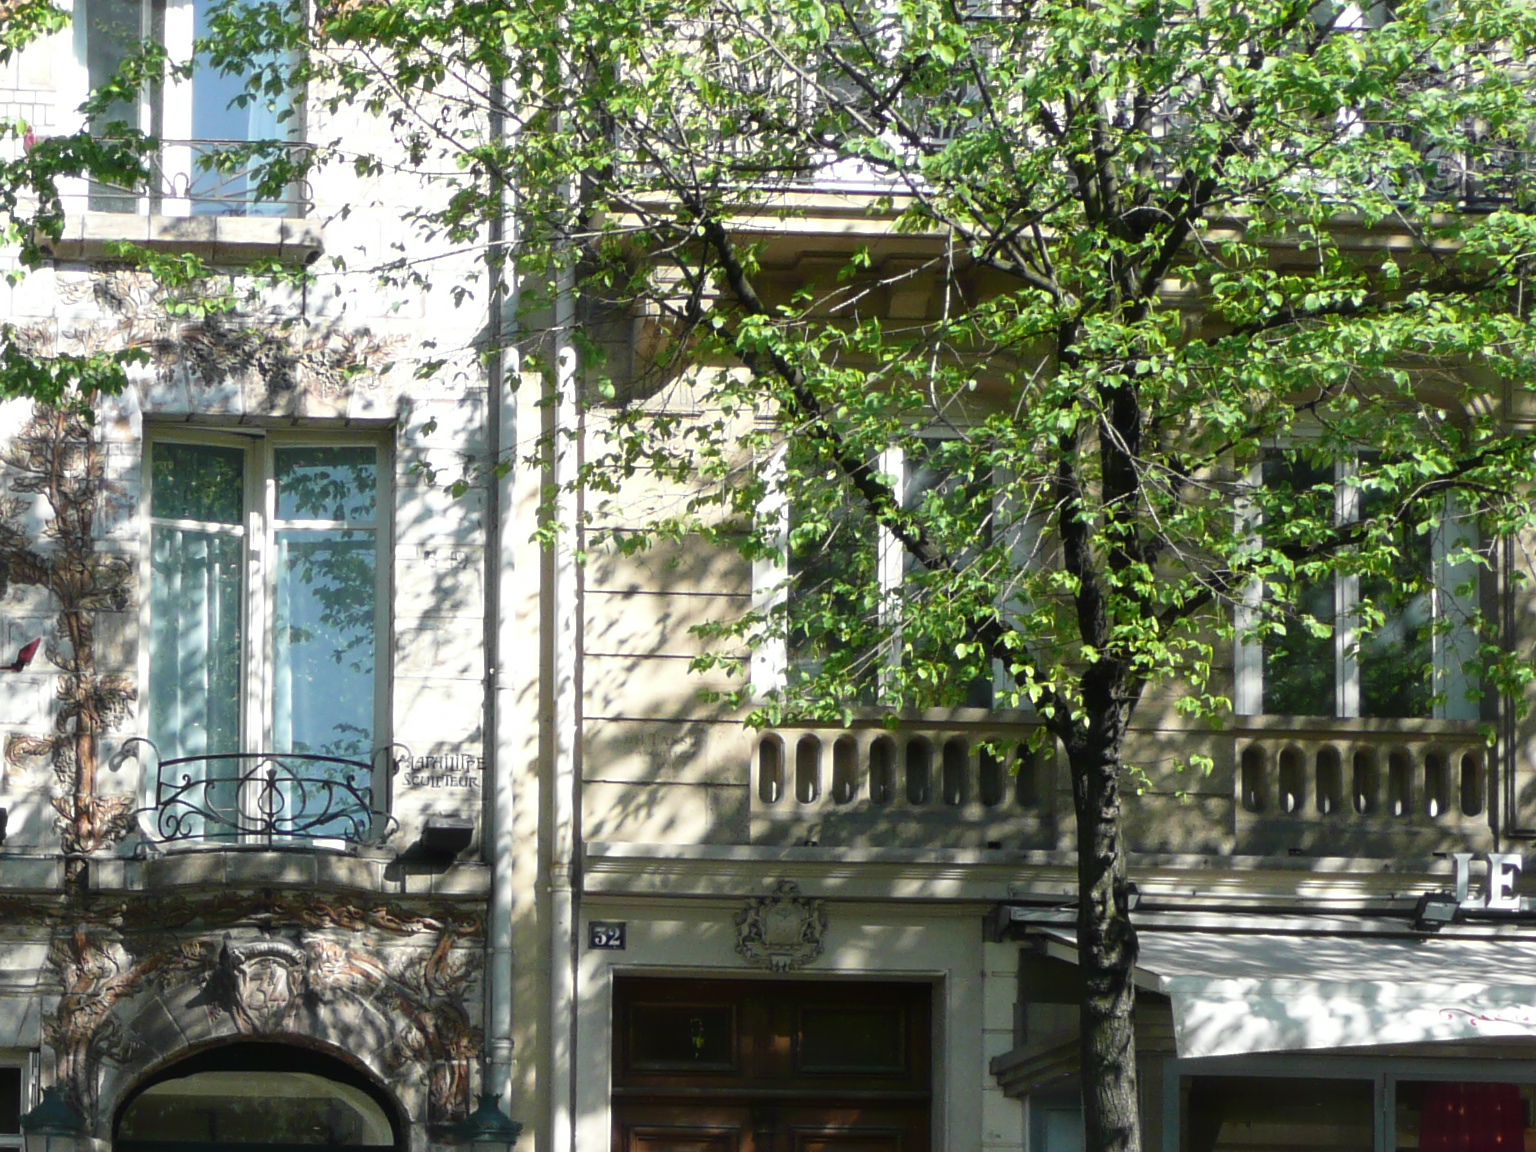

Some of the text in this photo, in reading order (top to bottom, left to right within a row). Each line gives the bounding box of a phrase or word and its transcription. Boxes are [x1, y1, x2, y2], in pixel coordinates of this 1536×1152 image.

[402, 773, 481, 788] SCULPTEUR
[1453, 853, 1522, 909] LE
[594, 926, 621, 946] 32
